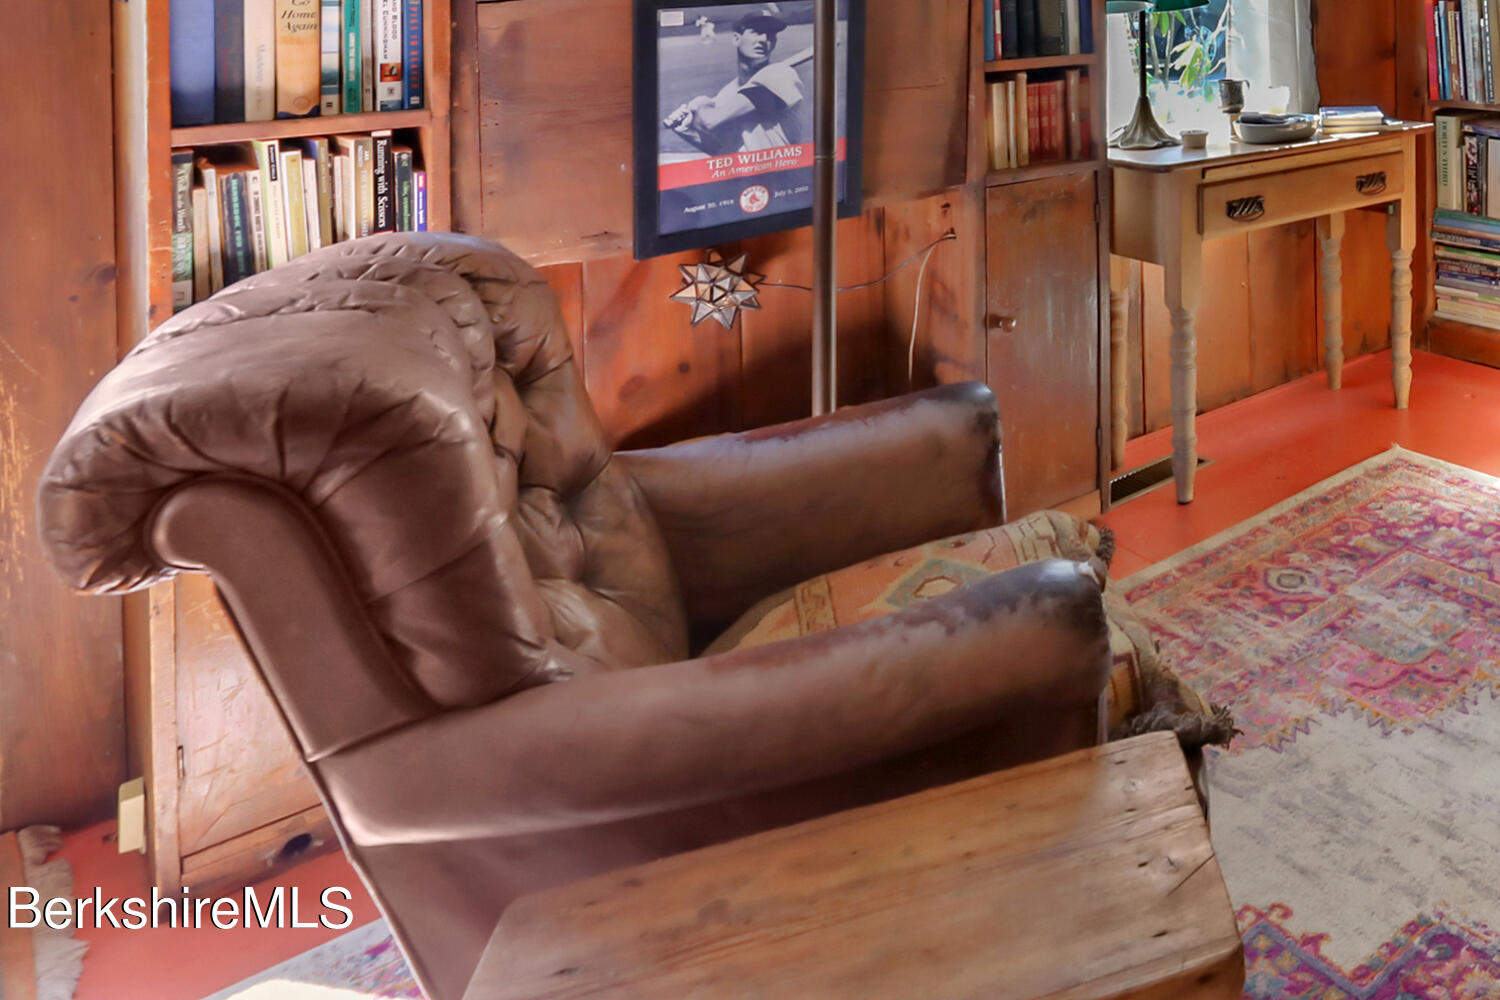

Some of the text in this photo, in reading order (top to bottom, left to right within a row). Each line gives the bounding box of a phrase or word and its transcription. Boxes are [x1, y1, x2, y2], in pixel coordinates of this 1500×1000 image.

[375, 140, 389, 228] Running with Scissors
[706, 146, 803, 171] TED WILLIAMS
